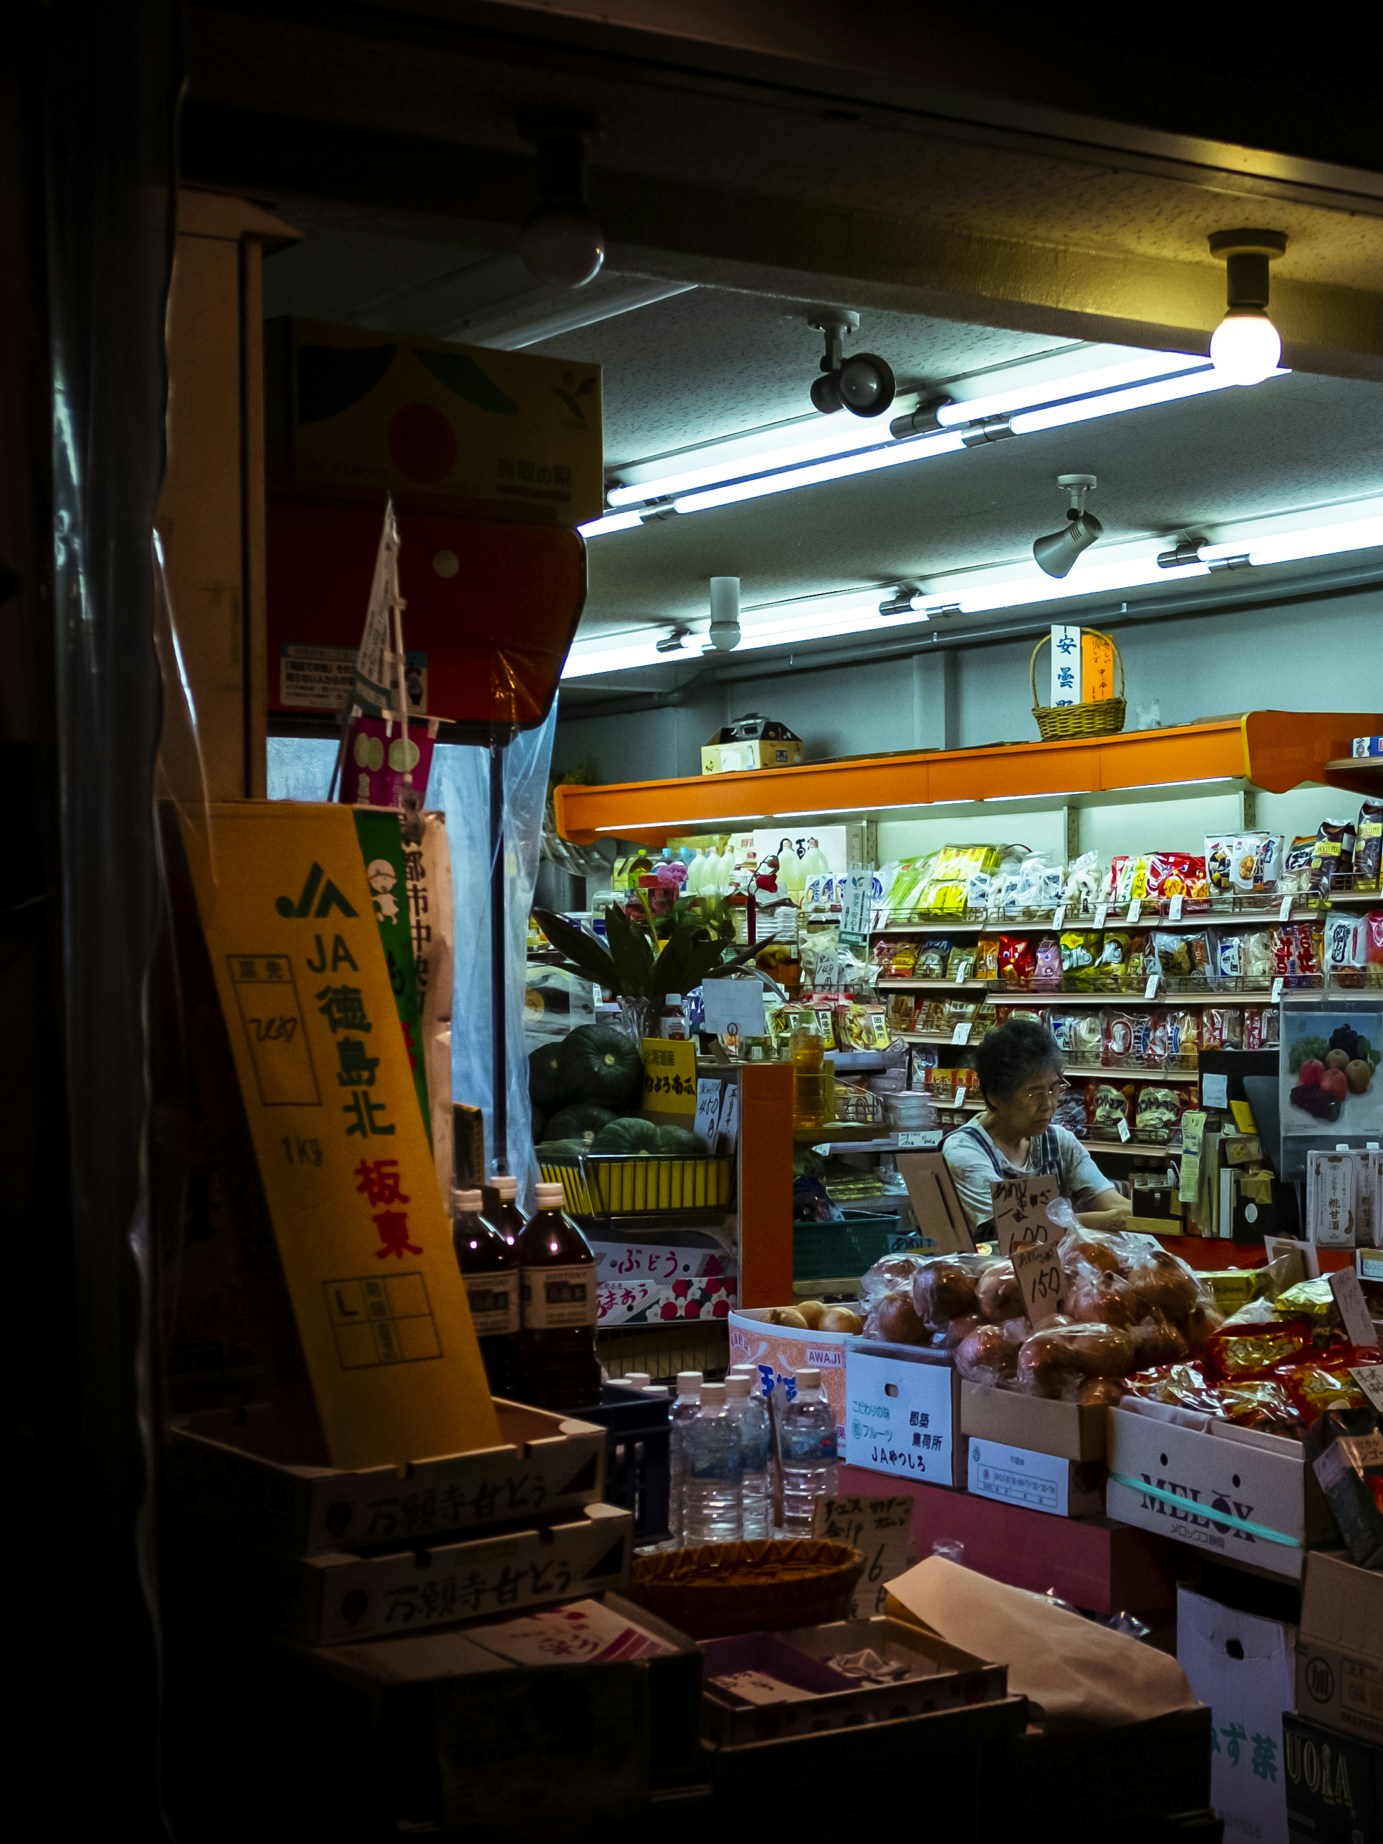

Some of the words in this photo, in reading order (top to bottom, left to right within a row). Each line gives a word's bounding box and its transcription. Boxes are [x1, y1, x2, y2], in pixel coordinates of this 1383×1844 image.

[617, 1249, 678, 1278] ぶどう
[1032, 1267, 1061, 1304] 150
[808, 1351, 842, 1365] AWAJI
[871, 1446, 927, 1473] JAやつしろ
